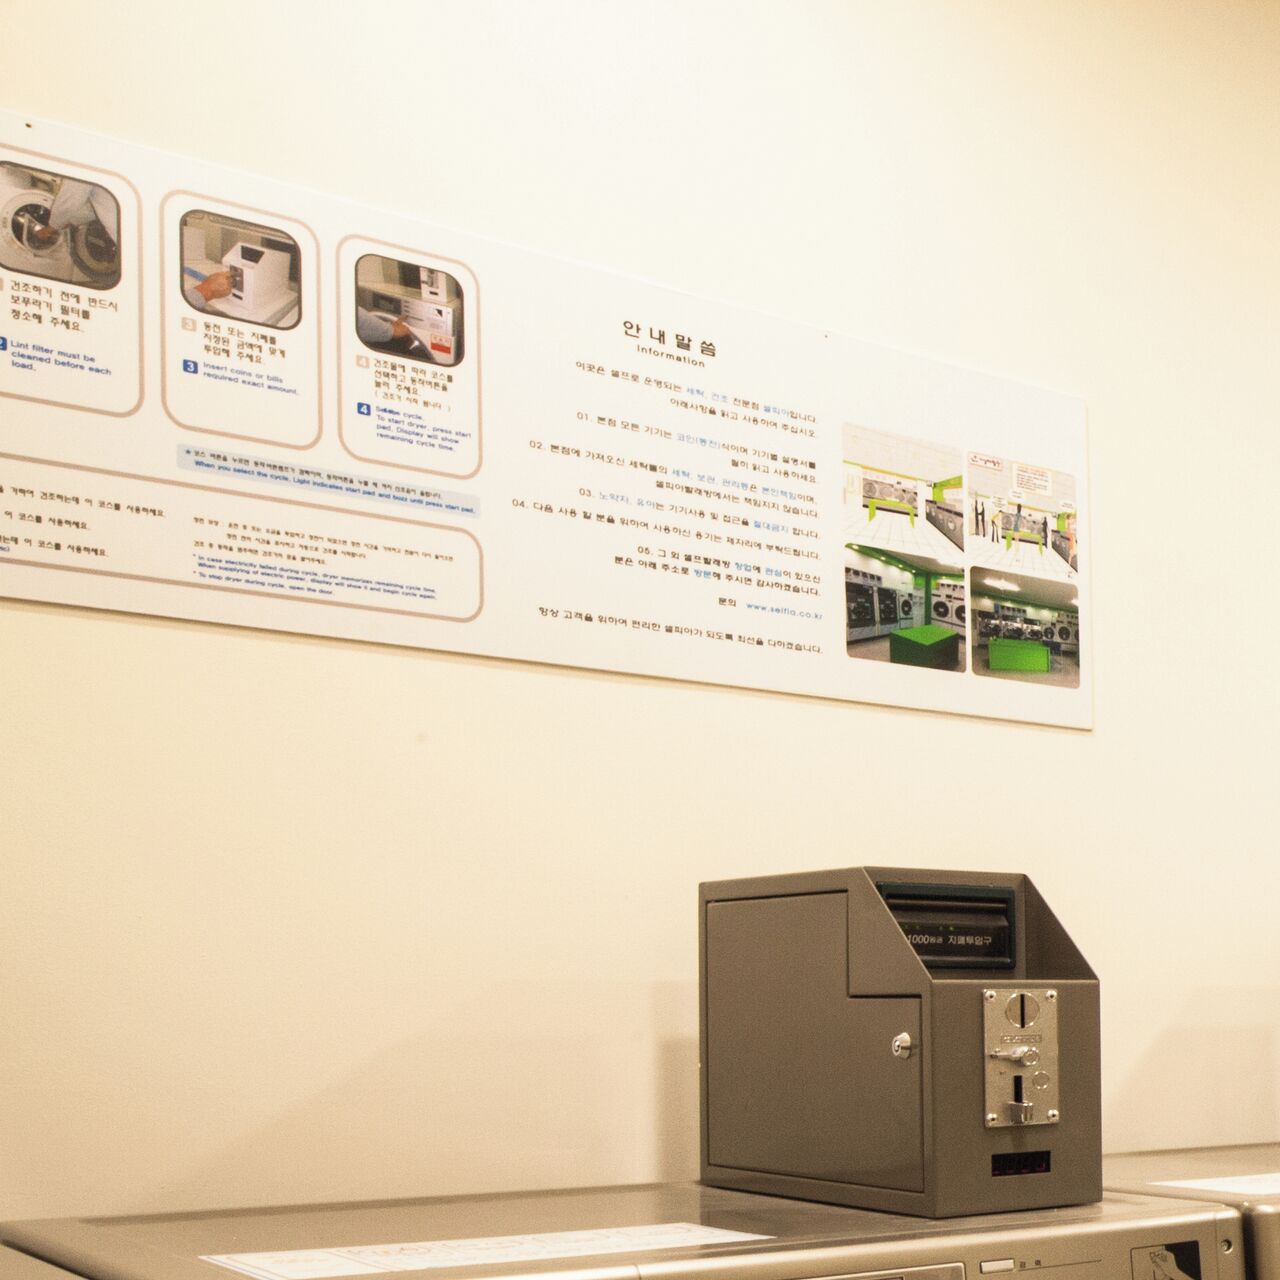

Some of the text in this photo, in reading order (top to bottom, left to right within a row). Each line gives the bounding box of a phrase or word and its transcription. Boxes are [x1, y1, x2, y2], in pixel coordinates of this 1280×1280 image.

[10, 339, 95, 363] Lint filter must be
[10, 350, 111, 375] cleaned before each
[636, 343, 705, 368] Information
[203, 361, 227, 371] Insert
[229, 368, 252, 377] coins
[266, 374, 283, 383] bills
[948, 935, 992, 946] 지폐투입구
